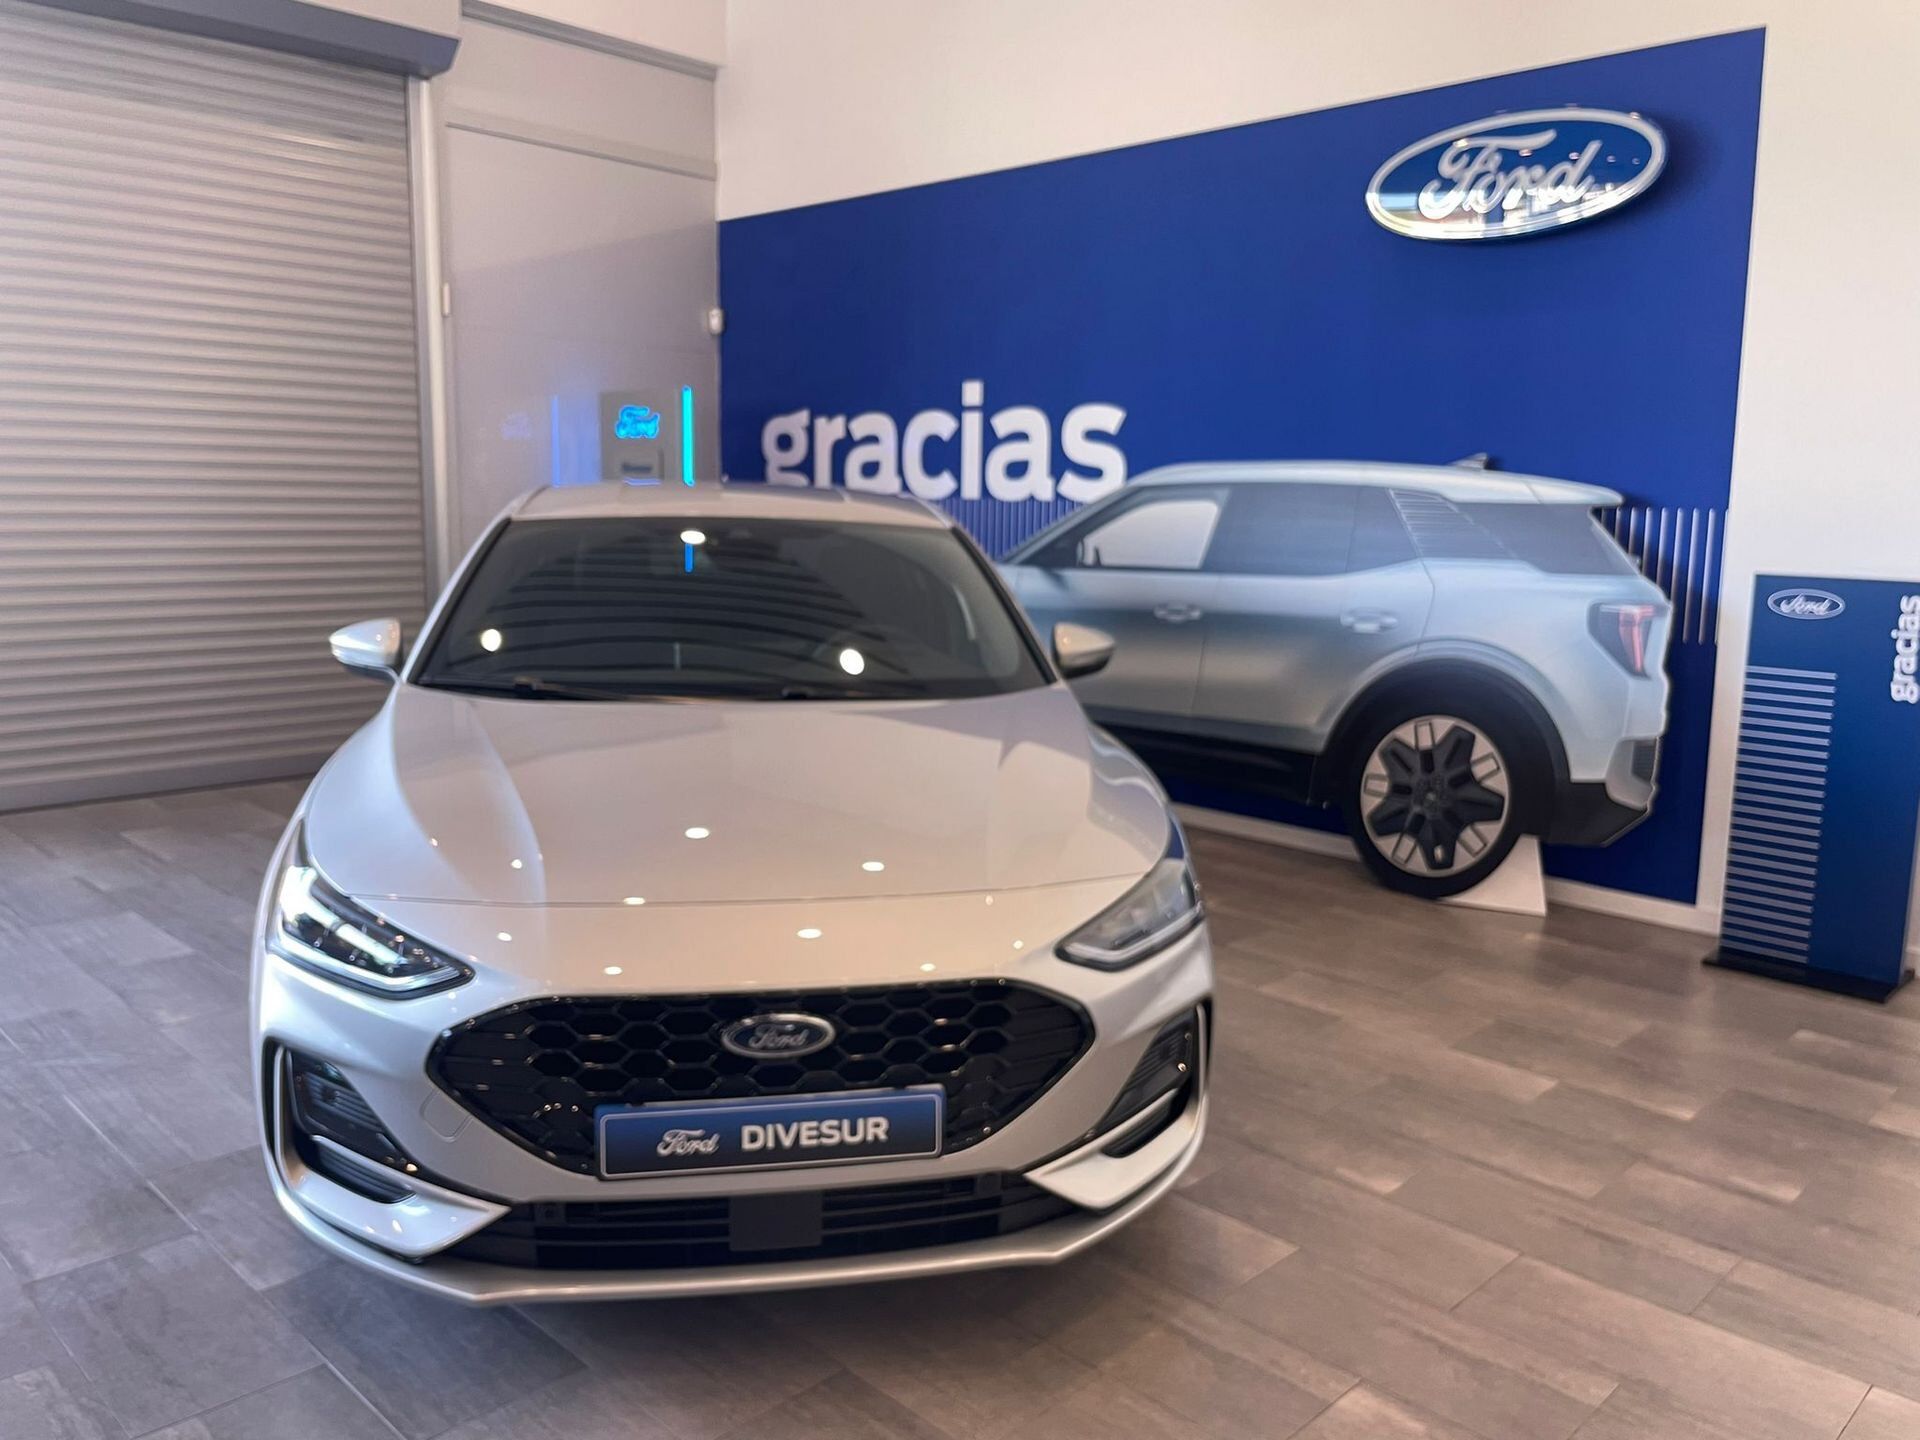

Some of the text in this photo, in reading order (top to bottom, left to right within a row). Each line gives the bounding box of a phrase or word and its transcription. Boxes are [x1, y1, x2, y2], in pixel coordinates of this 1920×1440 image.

[1417, 128, 1602, 220] Ford
[761, 379, 1128, 502] gracias
[1780, 592, 1831, 616] Ford
[1890, 595, 1920, 704] gracias
[748, 1024, 809, 1049] Ford
[656, 1116, 889, 1157] Ford DIVESUR
